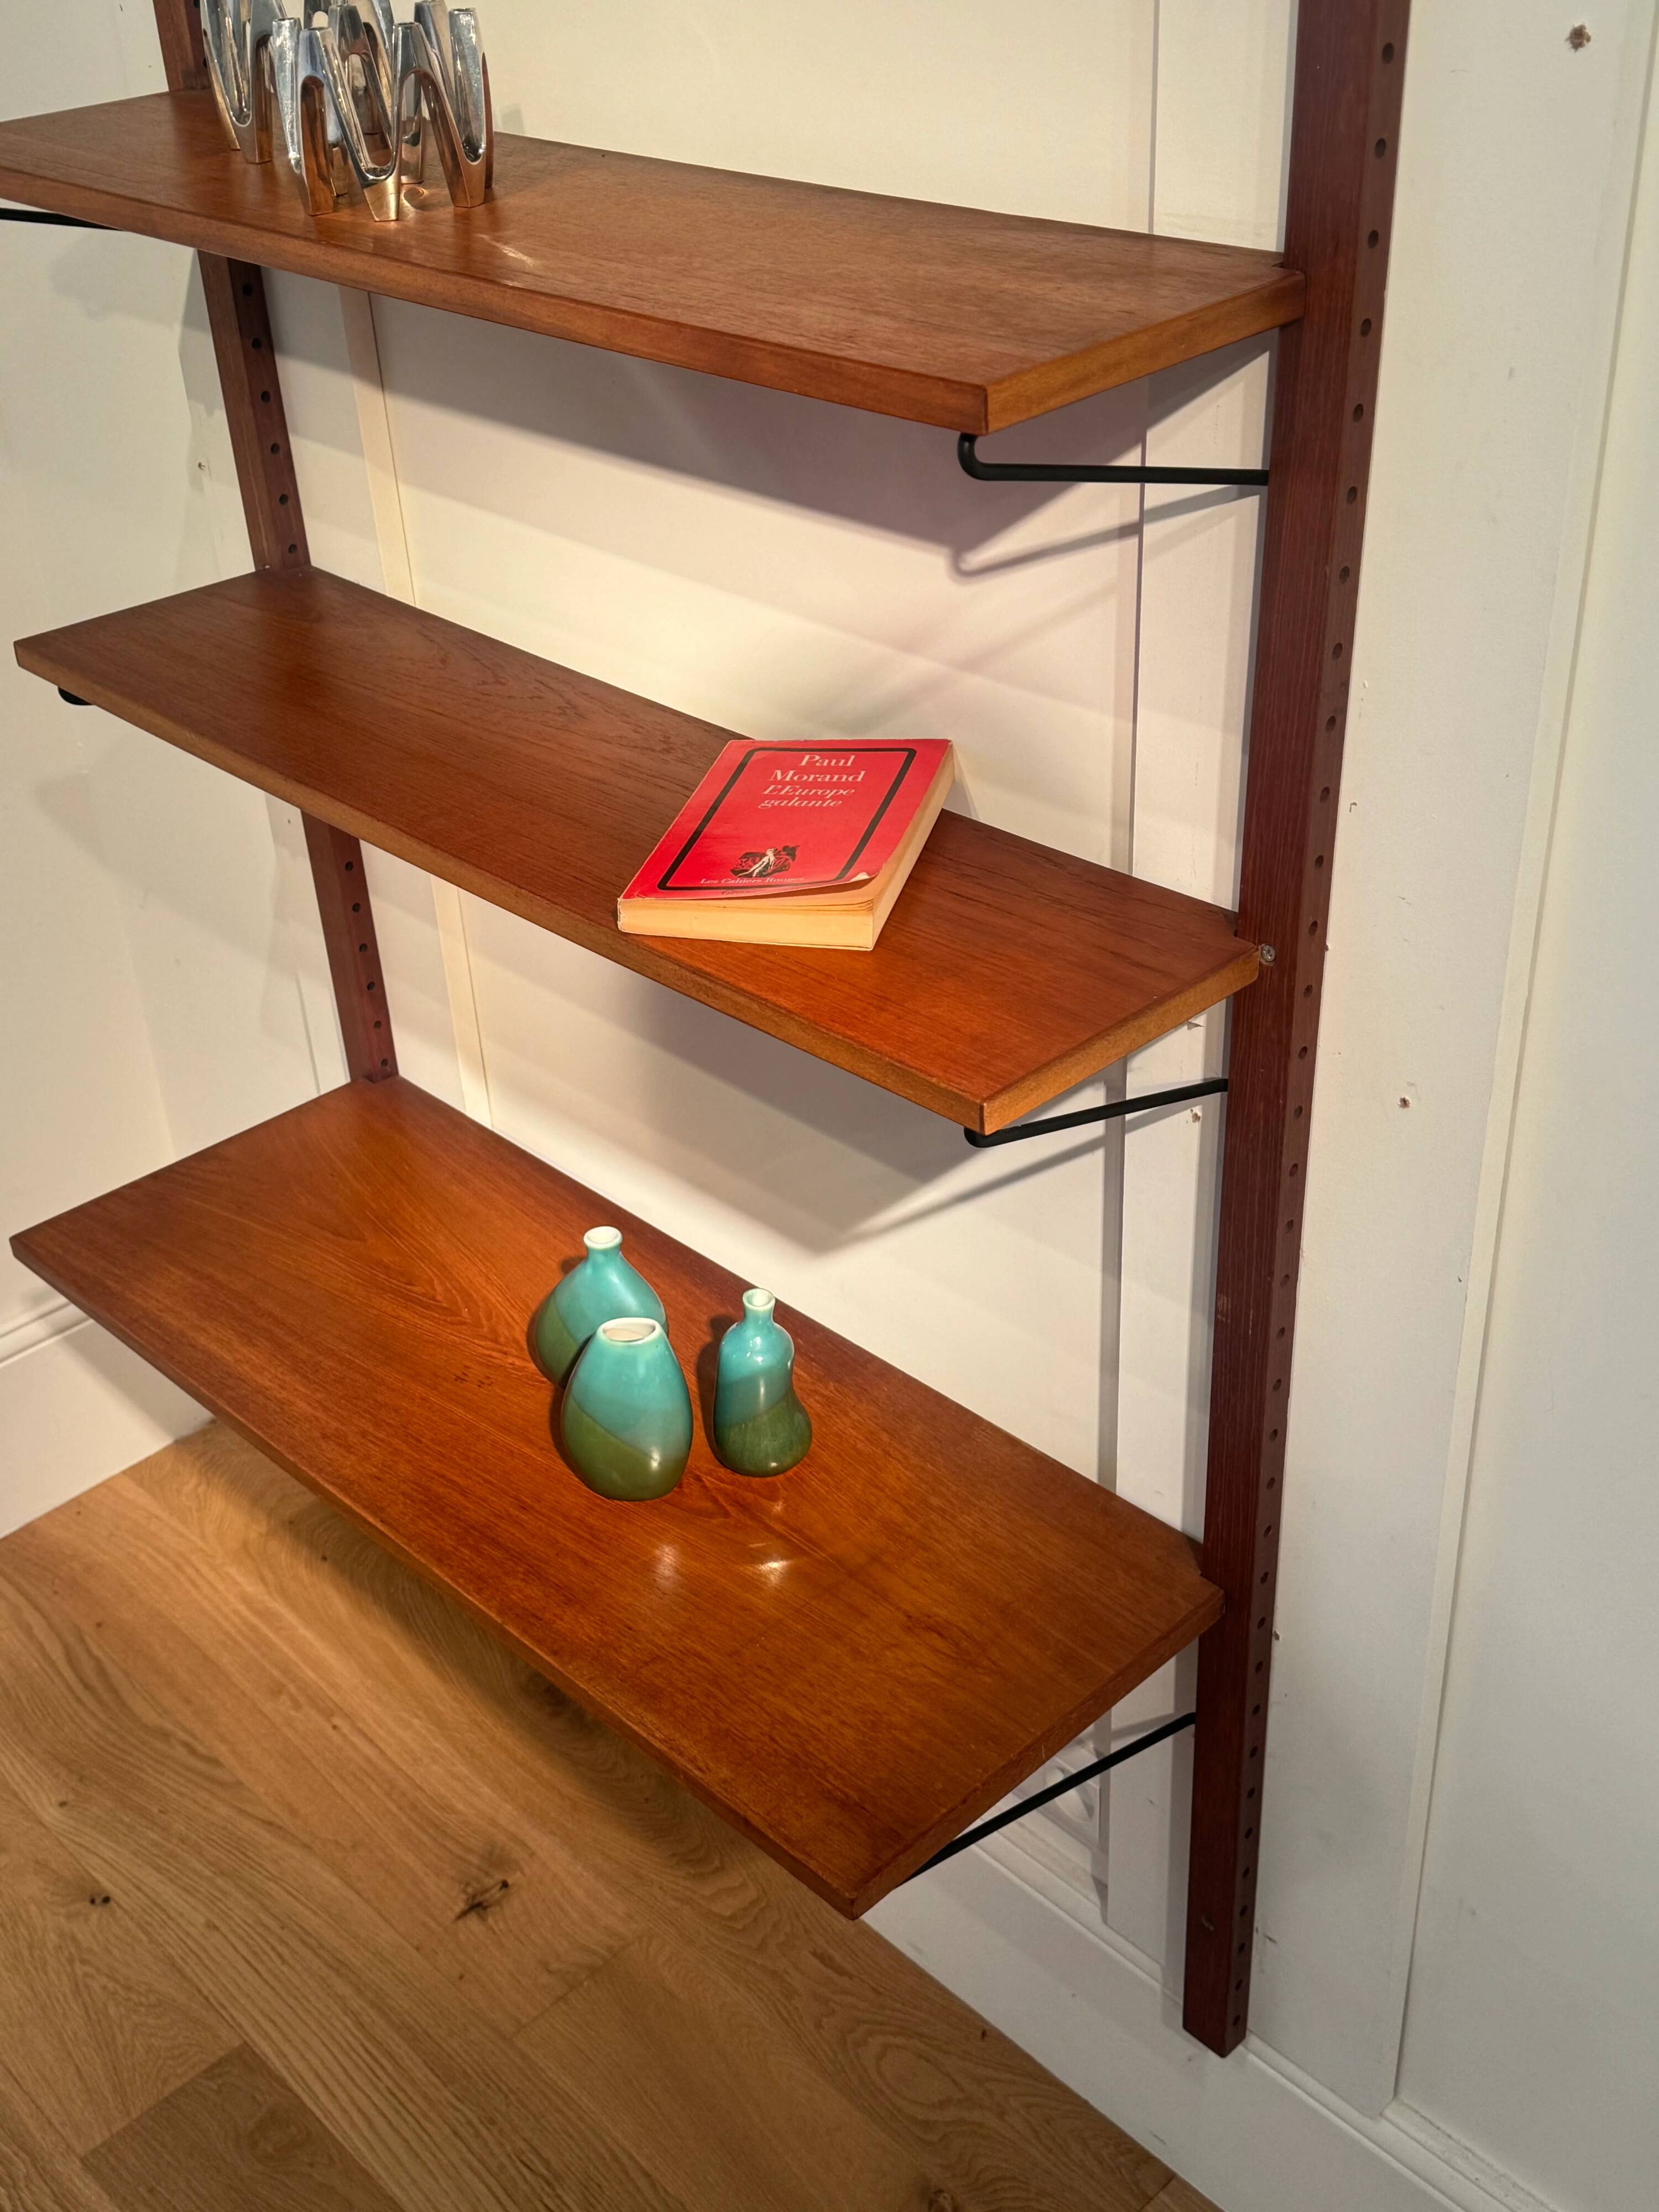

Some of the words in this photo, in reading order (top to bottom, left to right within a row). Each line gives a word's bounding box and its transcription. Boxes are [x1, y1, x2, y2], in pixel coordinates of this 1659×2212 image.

[797, 754, 855, 766] Paul
[767, 769, 866, 781] Morand
[761, 785, 855, 799] L'Europe
[758, 797, 842, 809] galante
